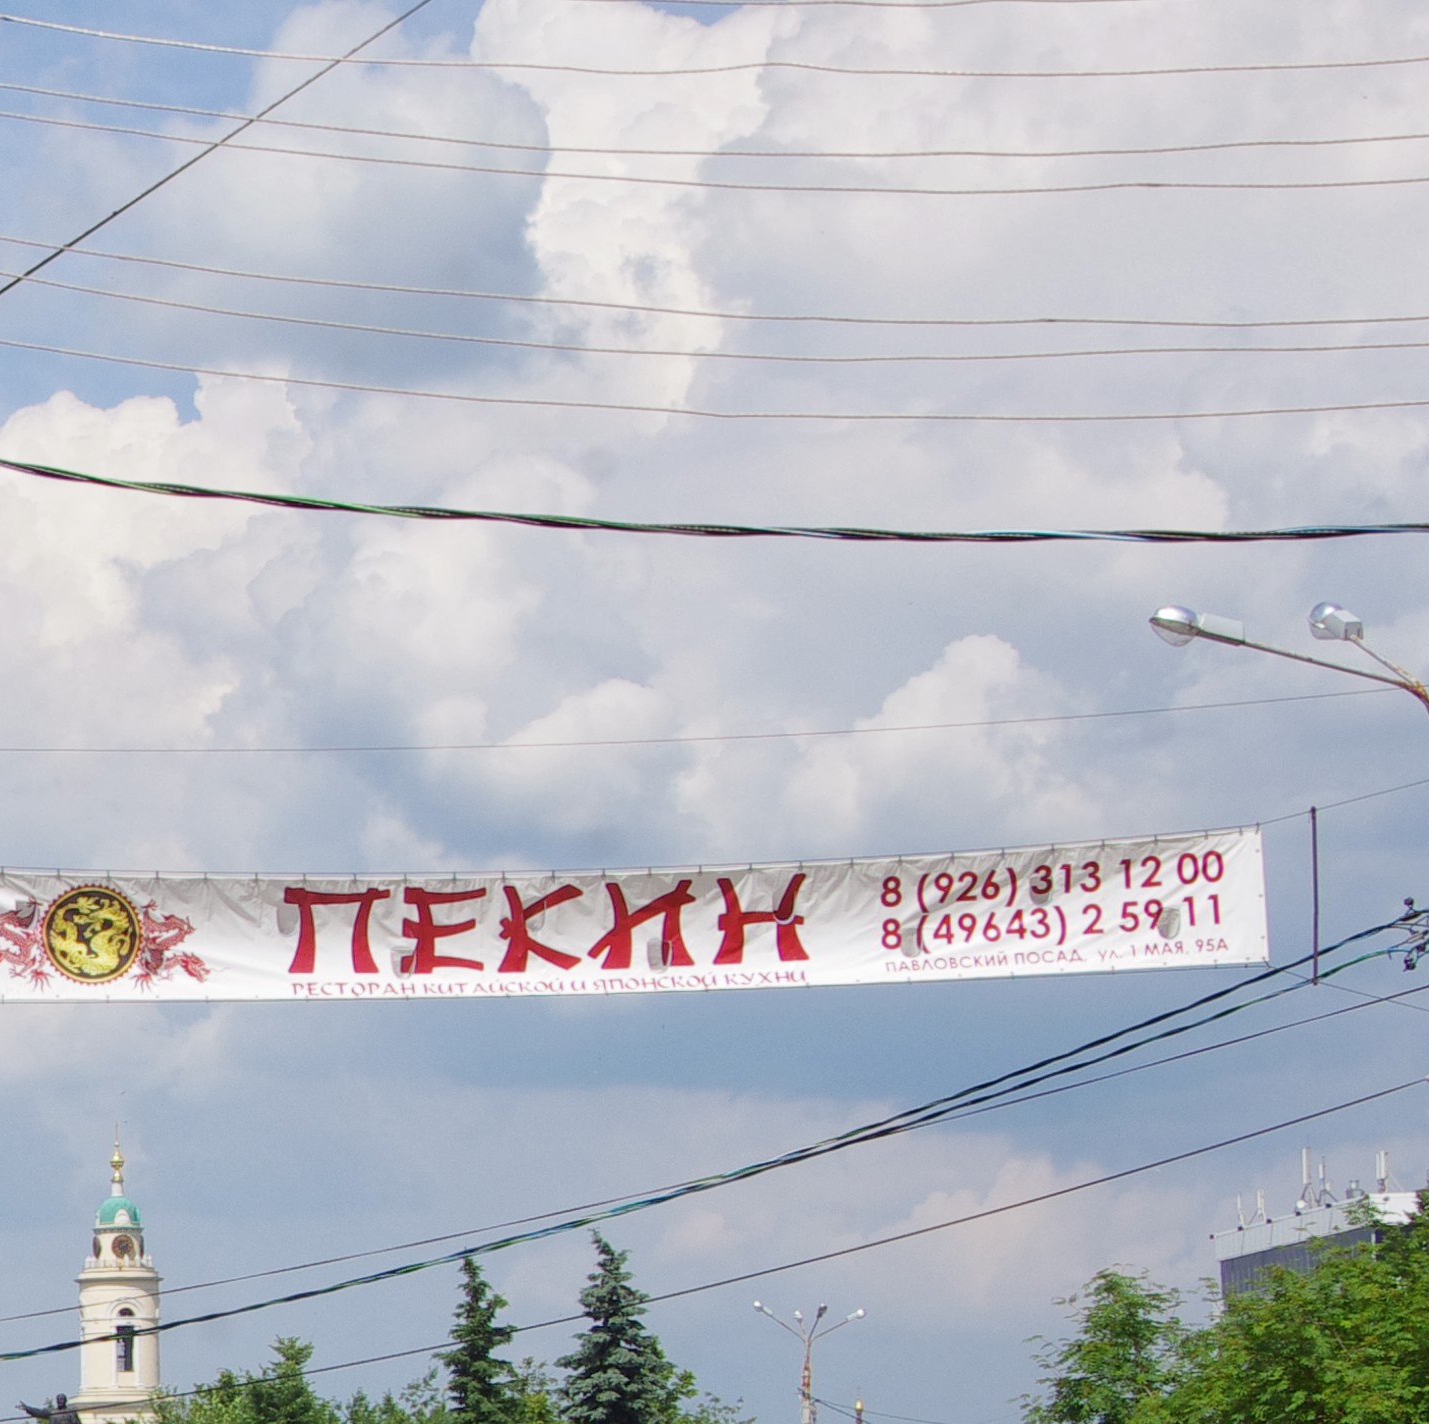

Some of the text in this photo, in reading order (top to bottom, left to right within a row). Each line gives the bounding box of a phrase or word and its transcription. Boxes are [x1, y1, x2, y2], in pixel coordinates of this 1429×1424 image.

[880, 850, 1224, 913] 8 (926) 313 12 00
[284, 873, 810, 974] ПЕКИН
[881, 894, 1220, 954] 8 (49643) 2 59 11
[291, 981, 415, 997] РЕСТОРАН
[593, 971, 718, 992] ЯПОНСКОЙ
[725, 970, 807, 986] КУХНИ
[886, 950, 1008, 973] ПАВЛОВСКИЙ
[1131, 945, 1137, 957] 1
[1195, 938, 1229, 952] 95А
